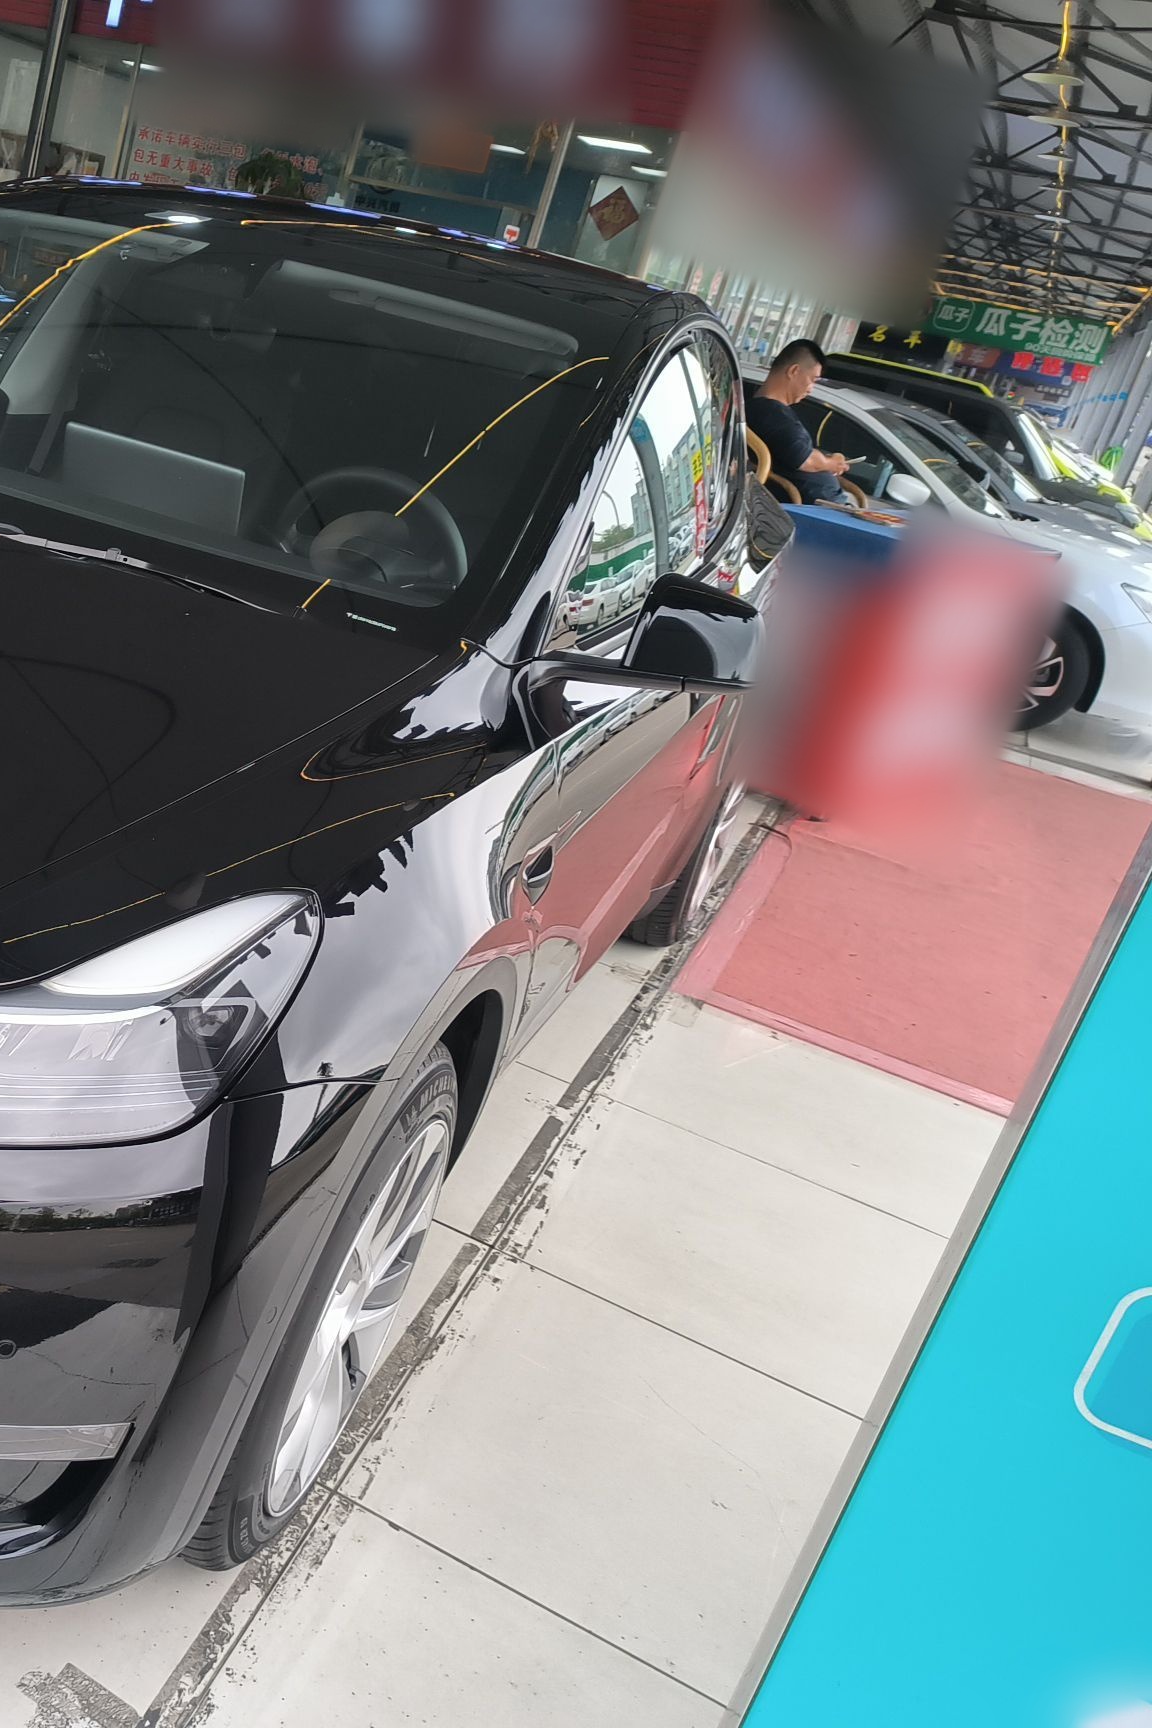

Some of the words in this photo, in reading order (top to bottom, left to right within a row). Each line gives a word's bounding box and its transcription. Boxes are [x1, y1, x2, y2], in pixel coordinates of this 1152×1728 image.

[133, 148, 214, 178] 包无重大事故
[938, 304, 971, 322] 瓜子
[975, 306, 1110, 354] 瓜子检测
